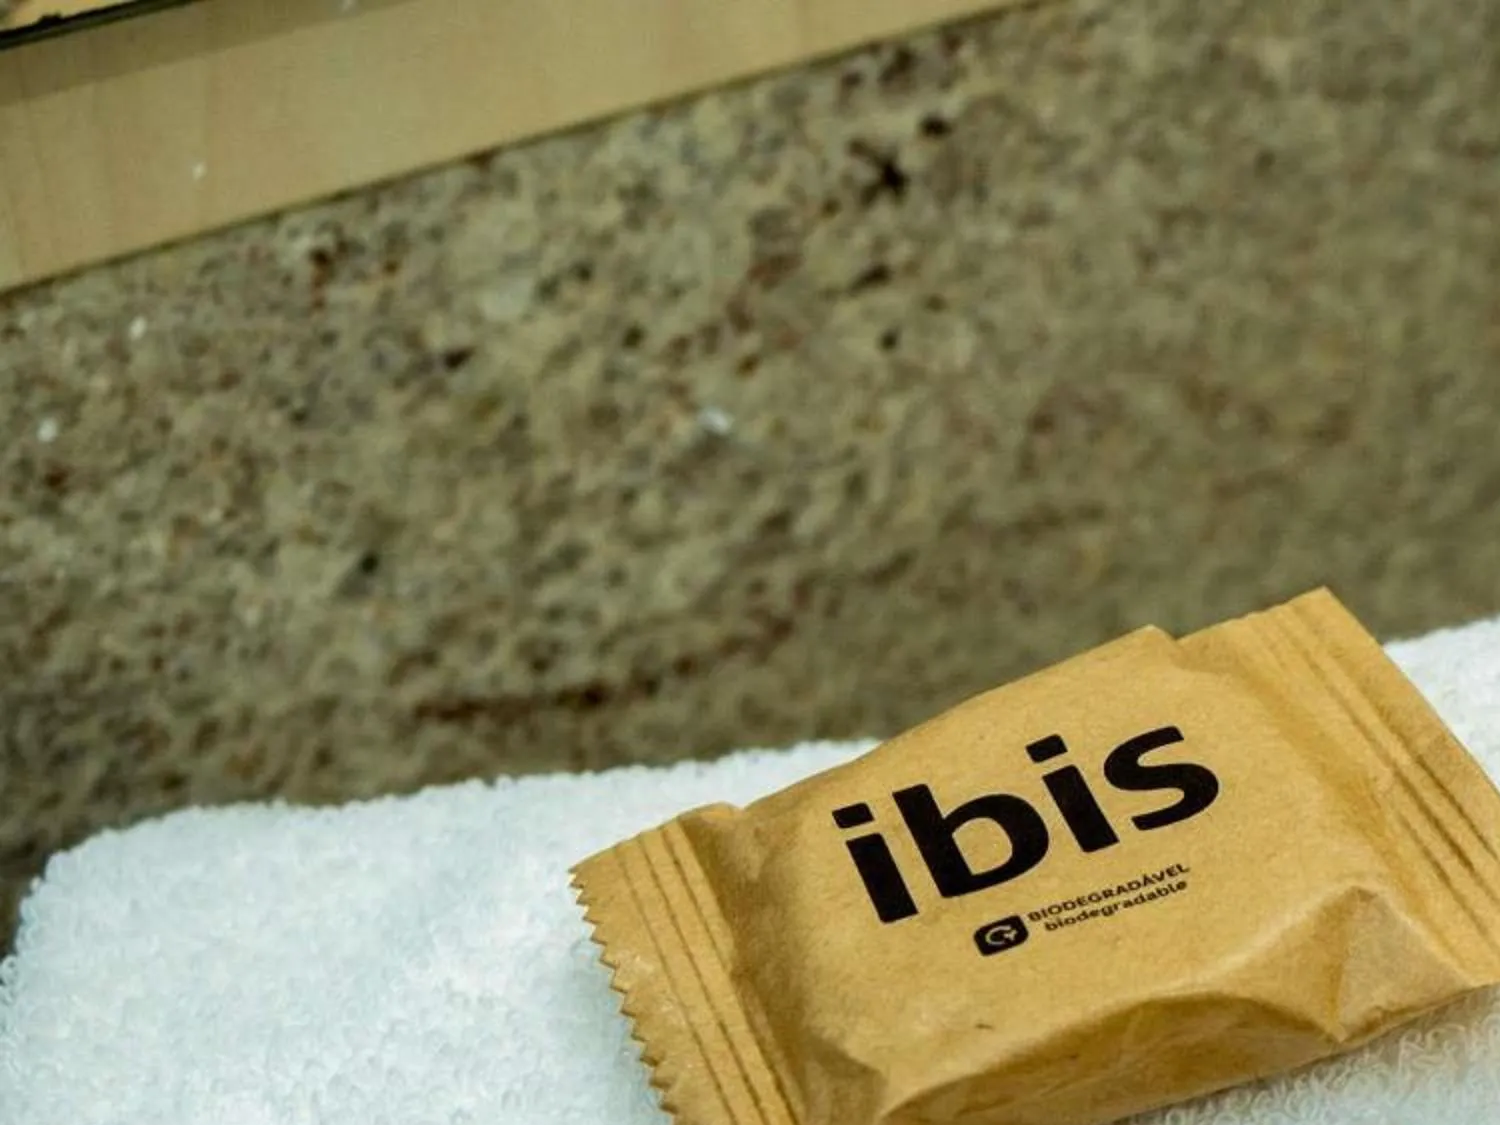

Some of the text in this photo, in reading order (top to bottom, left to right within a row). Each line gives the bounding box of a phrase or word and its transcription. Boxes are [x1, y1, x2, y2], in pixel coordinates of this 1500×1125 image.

[831, 724, 1220, 924] ibis
[1026, 862, 1191, 922] BIODEGRADÁVEL
[1044, 880, 1188, 932] biodegradable
